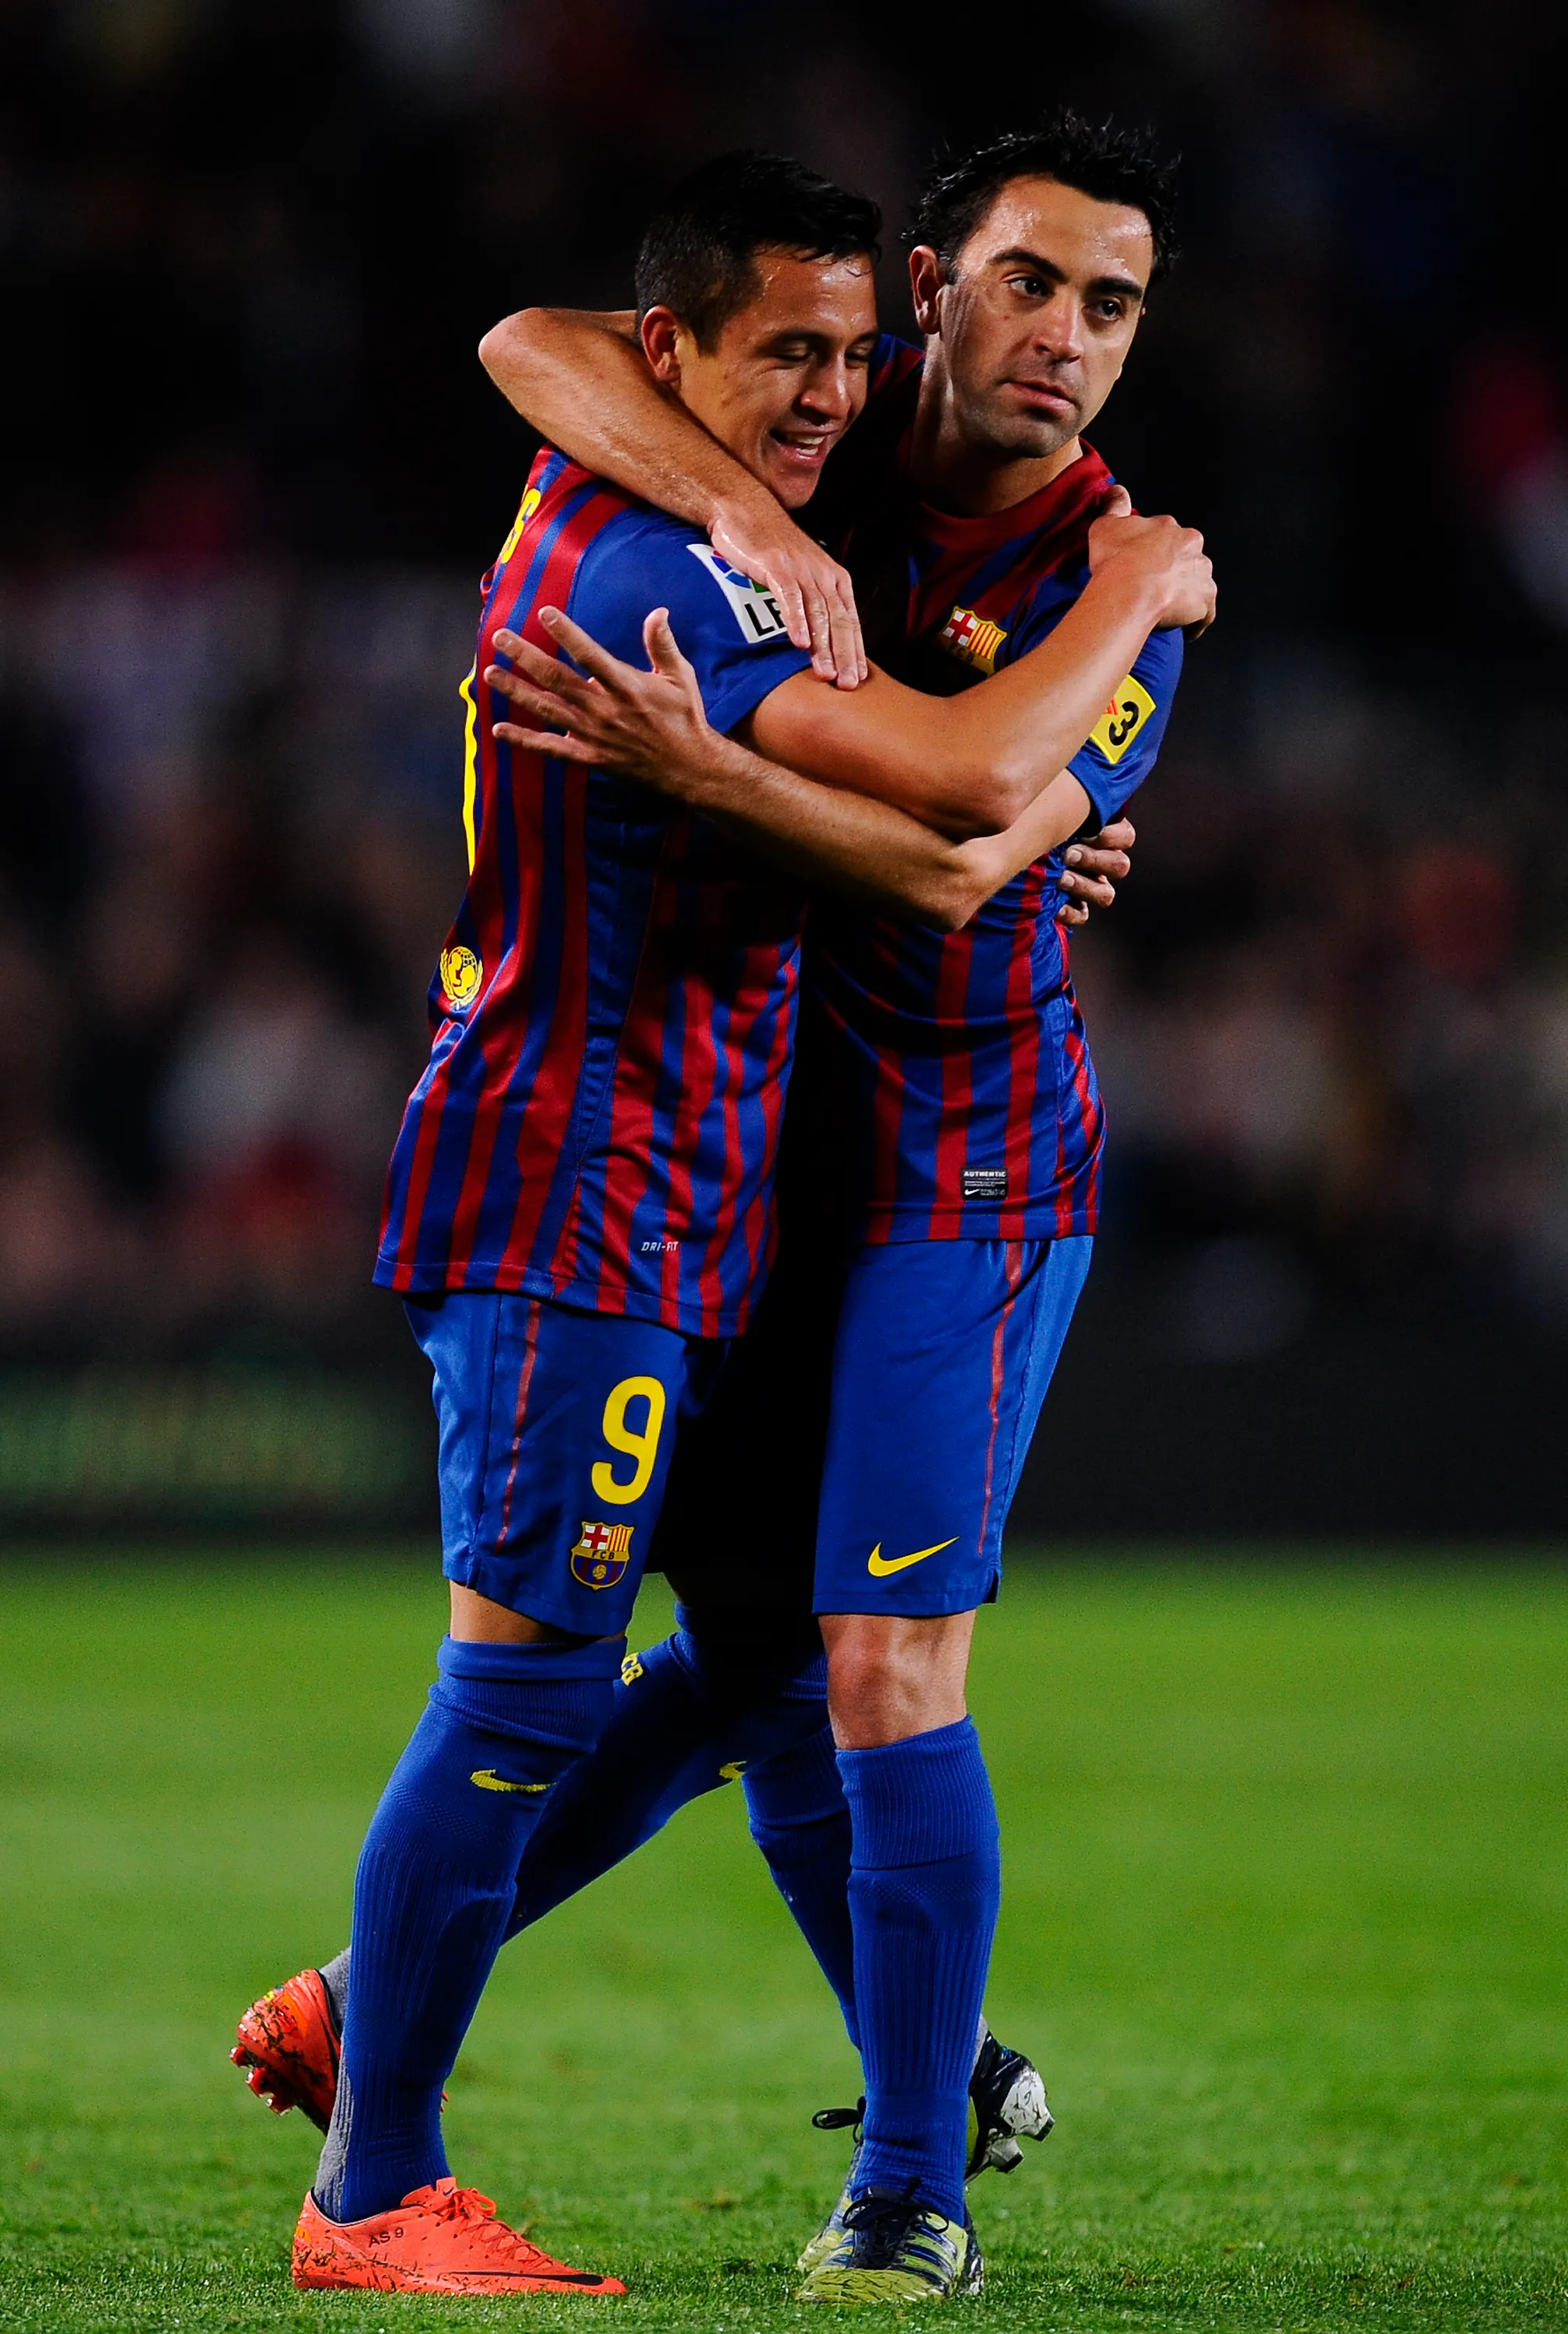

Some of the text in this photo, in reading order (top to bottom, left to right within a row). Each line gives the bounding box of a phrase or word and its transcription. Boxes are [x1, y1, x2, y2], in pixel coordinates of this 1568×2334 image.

[744, 598, 786, 636] LF
[1108, 701, 1139, 746] 3
[641, 1242, 679, 1252] DRI-FIT
[591, 1376, 666, 1505] 9
[591, 1550, 615, 1560] FCB
[369, 2227, 404, 2248] AS 9
